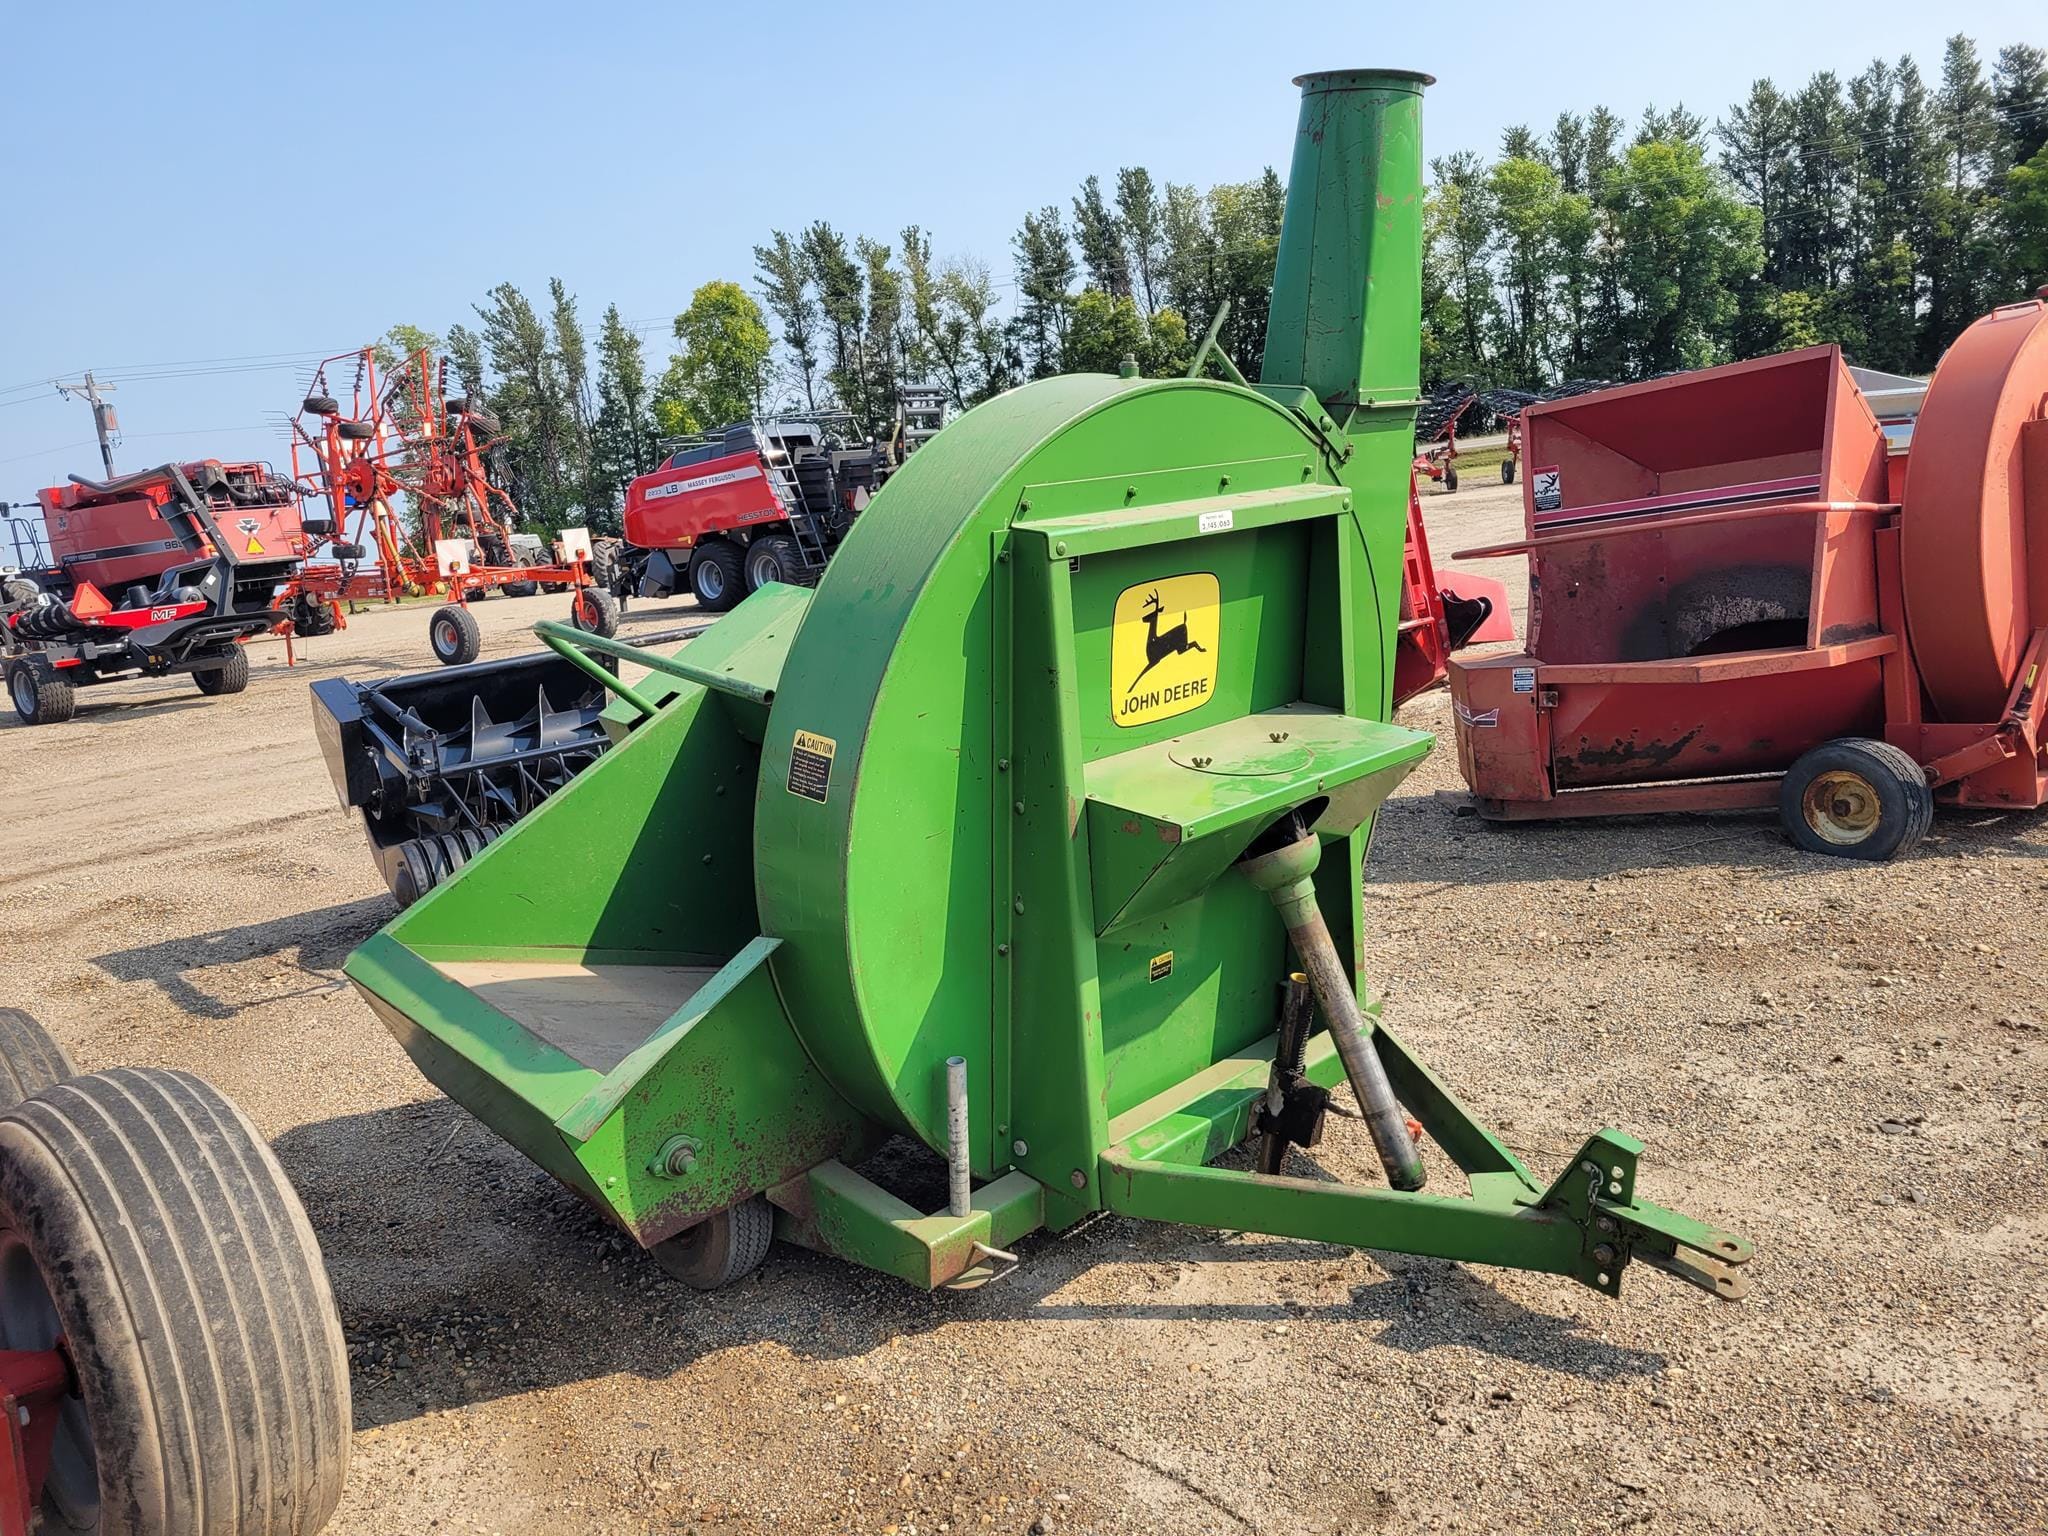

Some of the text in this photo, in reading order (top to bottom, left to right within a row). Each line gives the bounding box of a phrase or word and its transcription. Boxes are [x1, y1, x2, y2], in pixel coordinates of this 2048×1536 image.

[665, 484, 678, 495] LB
[688, 479, 707, 488] MASSEY
[709, 473, 736, 484] FERGUSON
[737, 509, 776, 521] HESSTON
[151, 609, 176, 622] MF
[1121, 678, 1208, 715] JOHN DEERE
[807, 738, 833, 754] CAUTION
